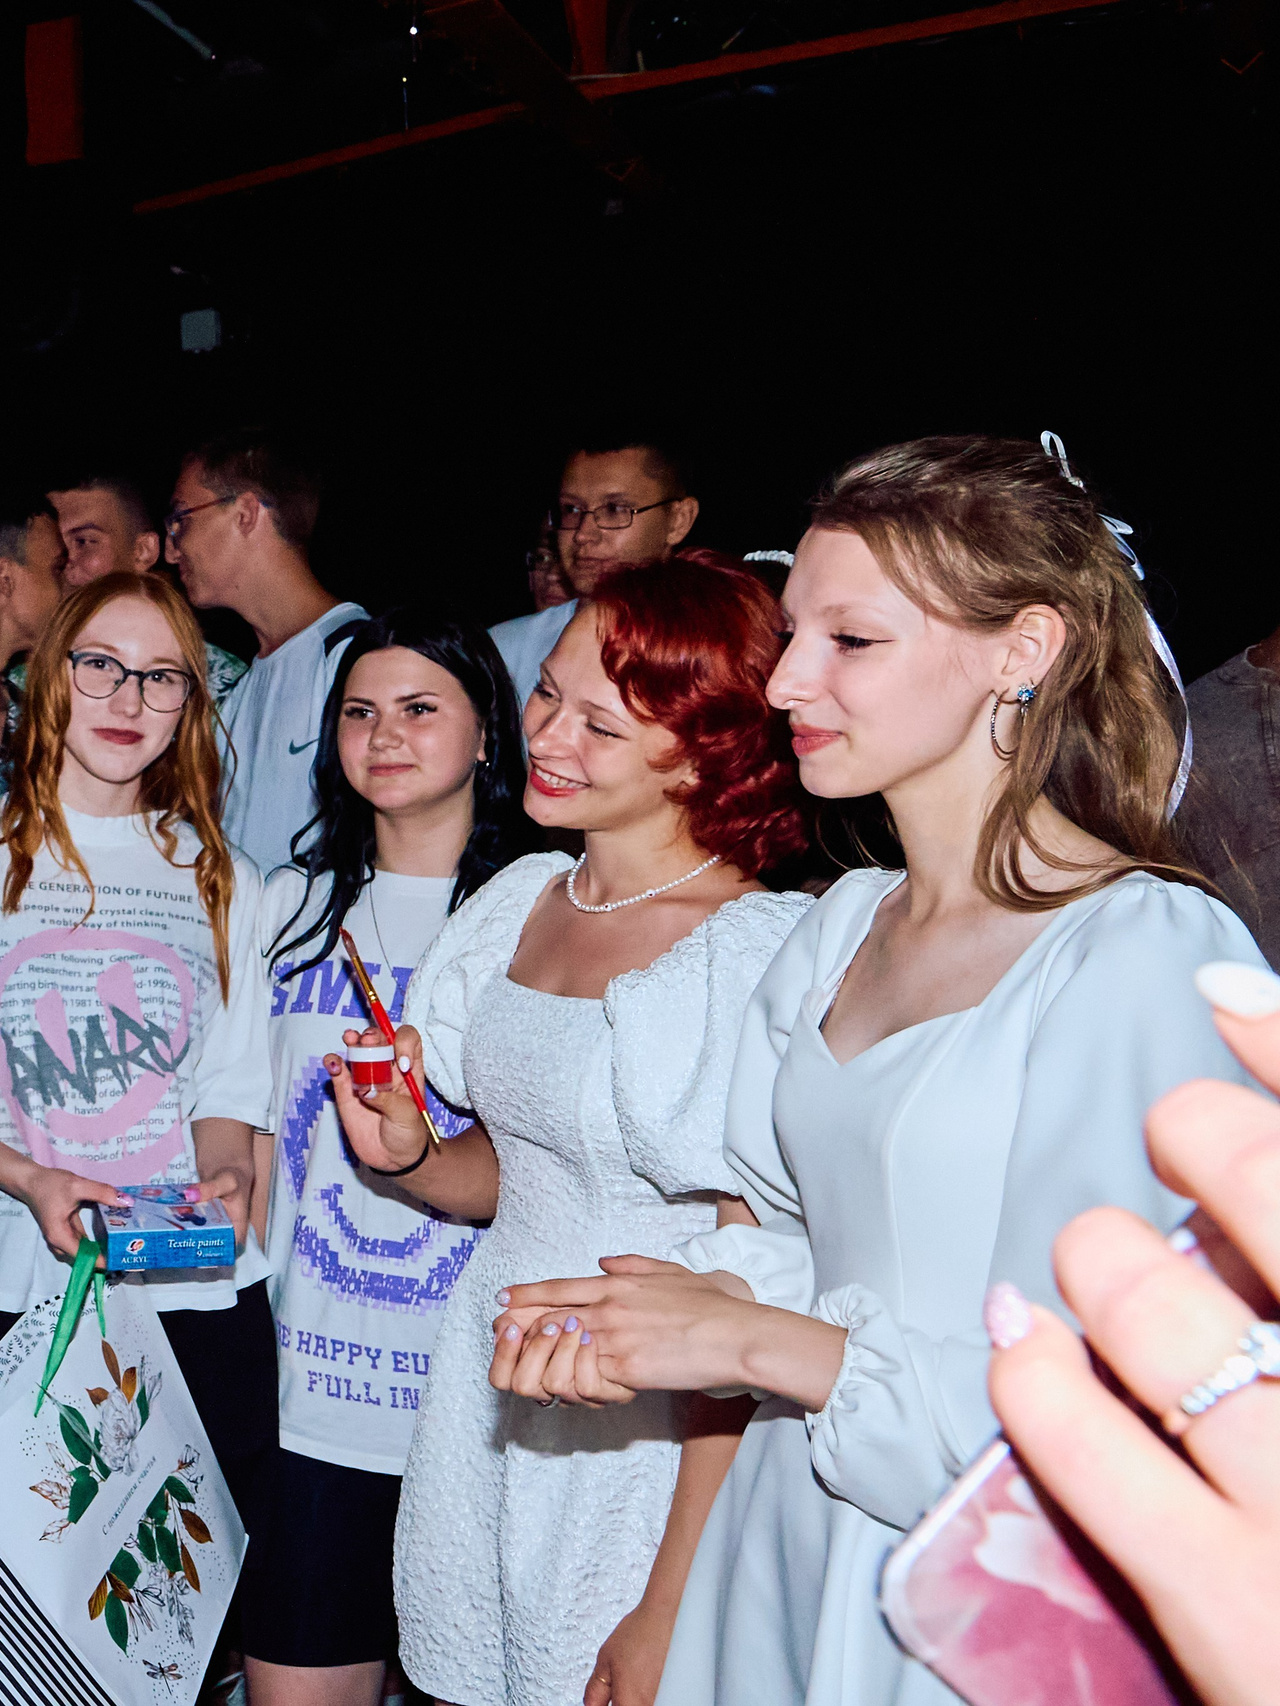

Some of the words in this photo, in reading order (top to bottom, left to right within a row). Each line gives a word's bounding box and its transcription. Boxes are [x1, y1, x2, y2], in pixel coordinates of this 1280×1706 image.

[125, 886, 142, 897] OF
[146, 889, 193, 903] FUTURE
[24, 902, 60, 912] people
[63, 904, 86, 915] with
[100, 907, 136, 916] crystal
[139, 908, 165, 917] clear
[168, 912, 195, 922] heart
[82, 922, 103, 931] way
[106, 920, 118, 928] of
[121, 920, 171, 931] thinking.
[61, 953, 104, 965] following
[28, 964, 81, 978] Researchers
[61, 983, 83, 994] years
[70, 998, 91, 1008] 1981
[99, 1088, 108, 1099] of
[74, 1104, 104, 1115] having
[167, 1238, 195, 1249] Textile
[197, 1239, 224, 1250] paints
[121, 1256, 148, 1264] ACRYL
[296, 1329, 382, 1370] HAPPY
[307, 1370, 381, 1406] FULL
